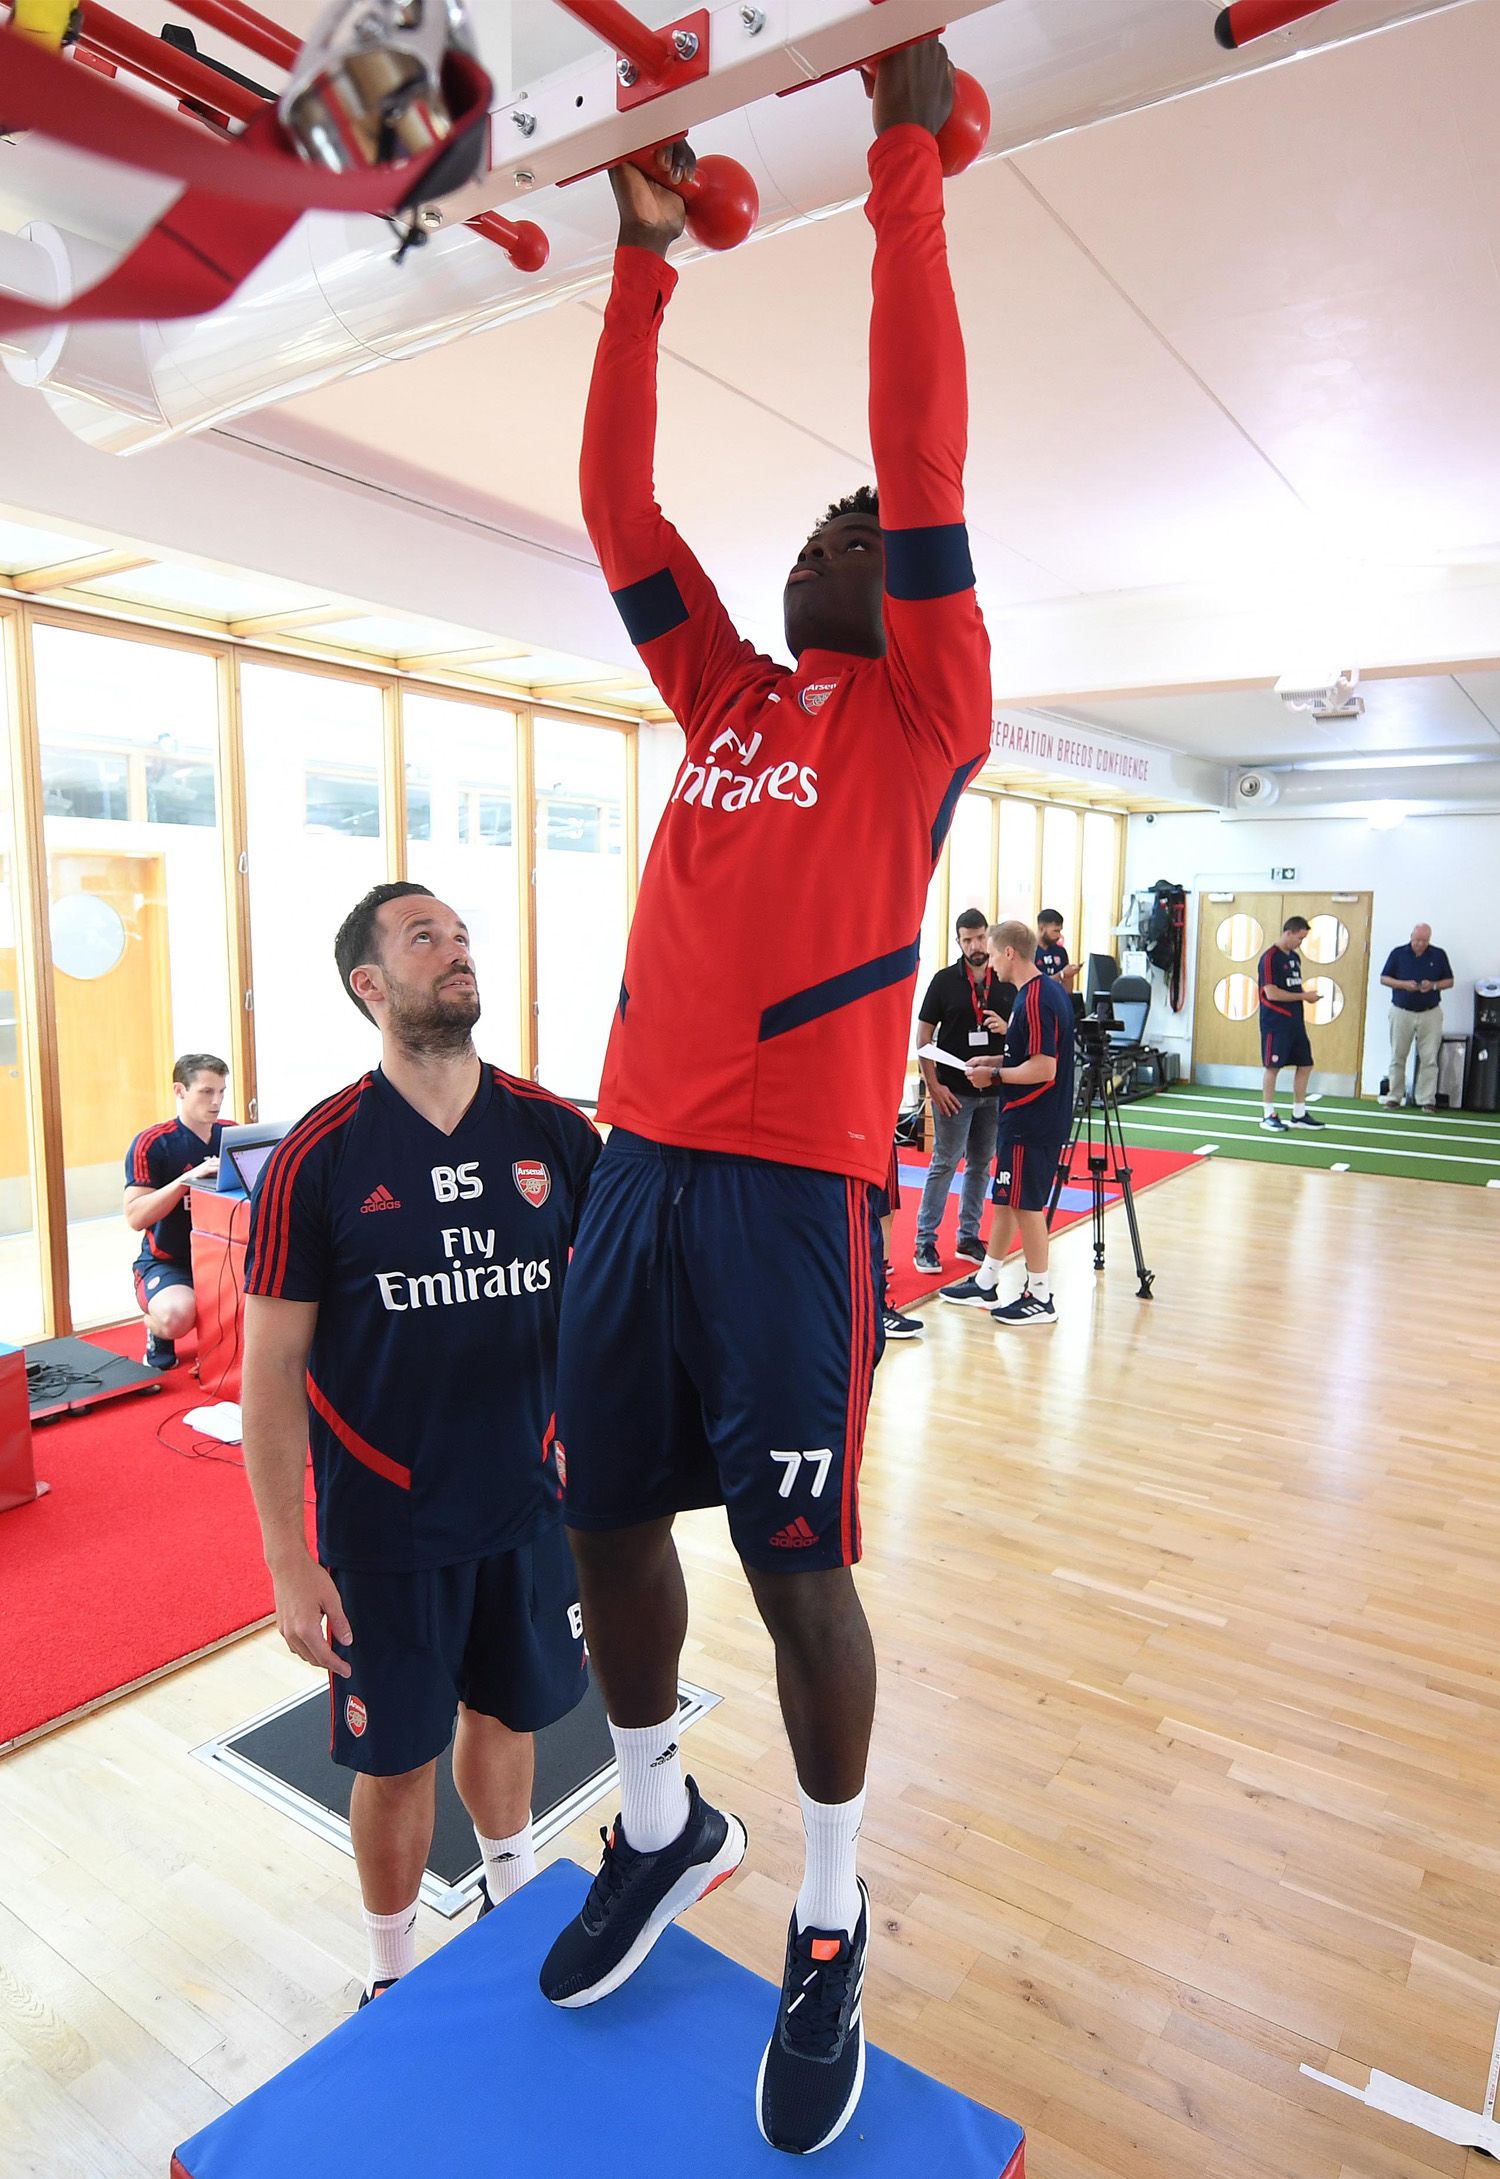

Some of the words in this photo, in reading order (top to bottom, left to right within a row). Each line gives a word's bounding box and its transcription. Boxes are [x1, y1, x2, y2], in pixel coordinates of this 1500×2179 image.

[807, 682, 837, 692] Arsen
[991, 720, 1054, 758] REPARATION
[1057, 738, 1093, 769] BREEDS
[1096, 748, 1149, 781] CONFIDENCE
[431, 1161, 484, 1203] BS
[996, 1171, 1011, 1186] JR
[360, 1199, 402, 1214] adidas
[441, 1226, 496, 1259] Fly
[375, 1257, 551, 1311] Emirates
[769, 1448, 833, 1498] 77
[567, 1602, 584, 1640] B
